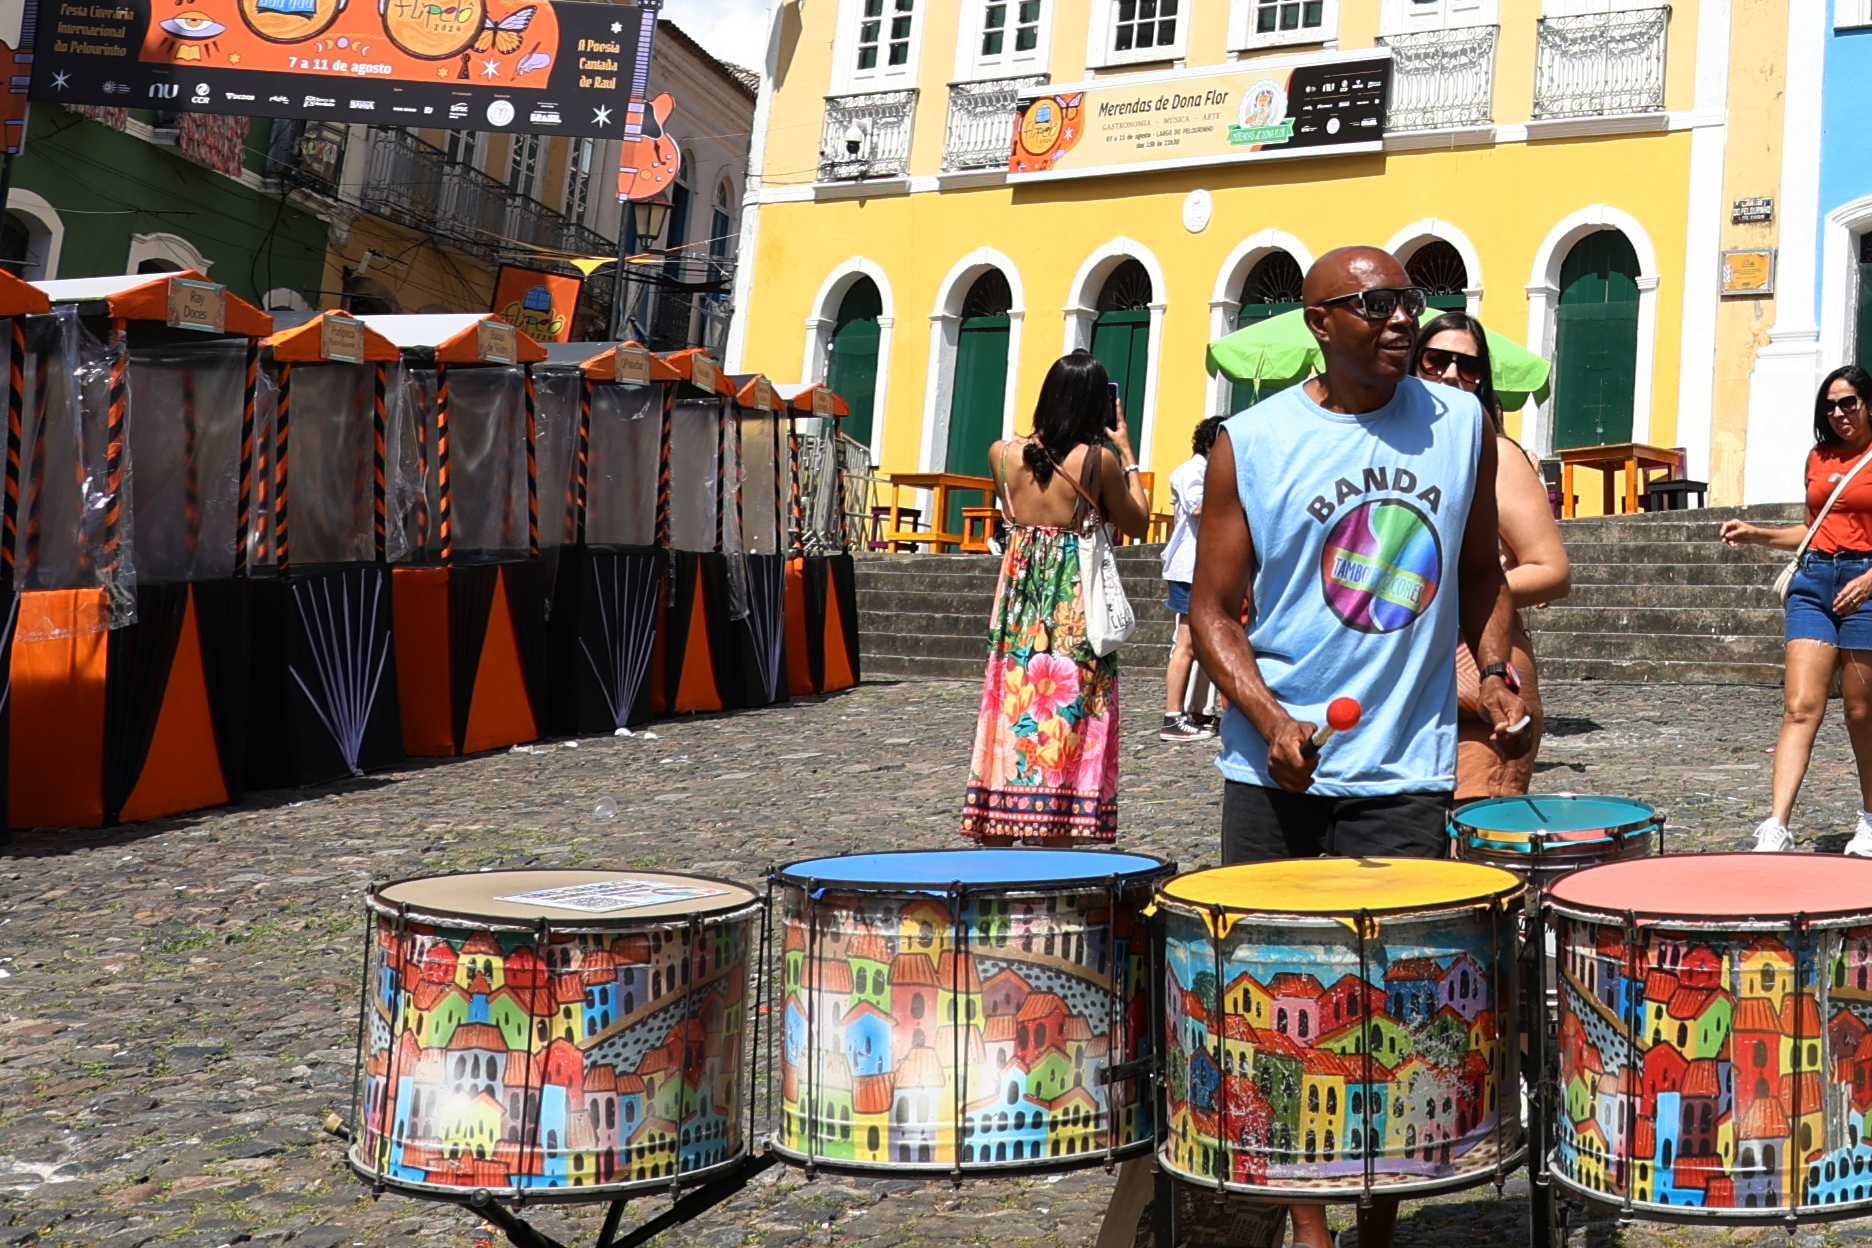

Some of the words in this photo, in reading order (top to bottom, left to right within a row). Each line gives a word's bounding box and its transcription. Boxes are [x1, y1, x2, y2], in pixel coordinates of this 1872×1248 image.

[60, 3, 88, 16] Festa
[90, 6, 134, 20] Literária
[57, 22, 126, 38] Internacional
[433, 24, 462, 32] 2024
[54, 40, 68, 52] do
[69, 41, 127, 57] Pelourinho
[578, 39, 585, 52] A
[587, 40, 620, 53] Poesia
[288, 56, 297, 68] 7
[300, 60, 309, 69] a
[313, 58, 328, 71] 11
[332, 59, 348, 72] de
[351, 62, 392, 76] agosto
[579, 57, 618, 72] Cantada
[579, 75, 592, 88] de
[594, 76, 616, 90] Raul
[148, 83, 179, 99] nu
[1098, 98, 1152, 117] Merendas
[1155, 95, 1170, 111] de
[1171, 94, 1202, 110] Dona
[1204, 89, 1229, 106] Flor
[1102, 120, 1151, 131] GASTRONOMIA
[1202, 112, 1221, 121] ARTE
[190, 291, 205, 306] Ray
[183, 305, 207, 320] Doces
[1306, 467, 1442, 524] BANDA
